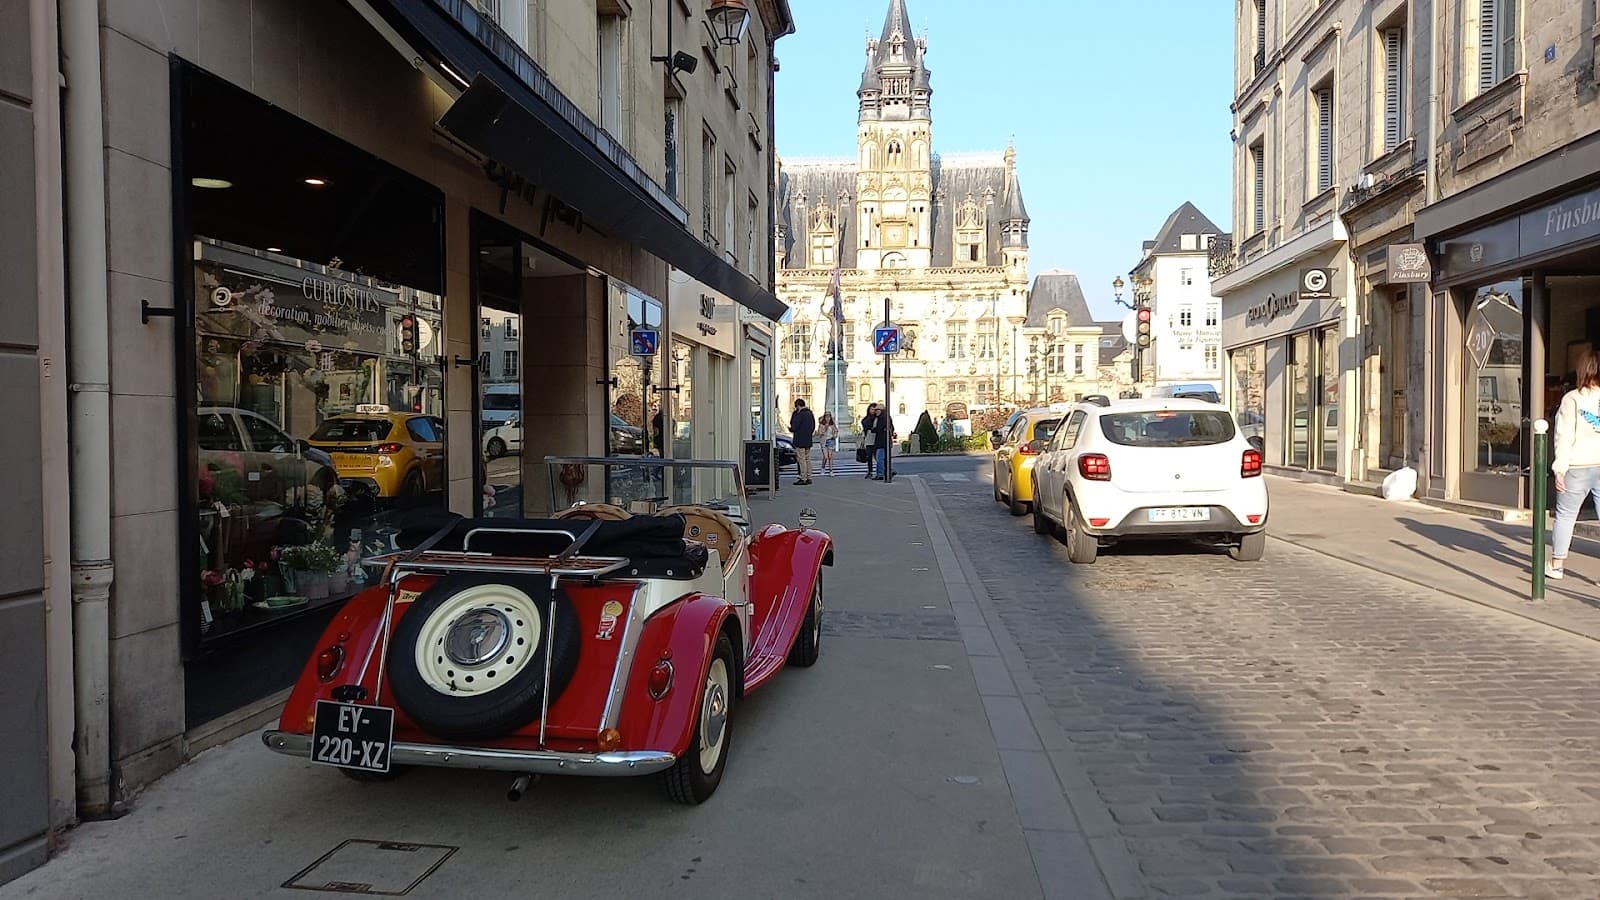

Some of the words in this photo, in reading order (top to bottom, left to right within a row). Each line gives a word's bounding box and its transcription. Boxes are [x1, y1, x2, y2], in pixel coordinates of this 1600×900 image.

[1392, 271, 1429, 280] Finsbury
[338, 705, 370, 733] EY-
[317, 735, 385, 769] 220-XZ
